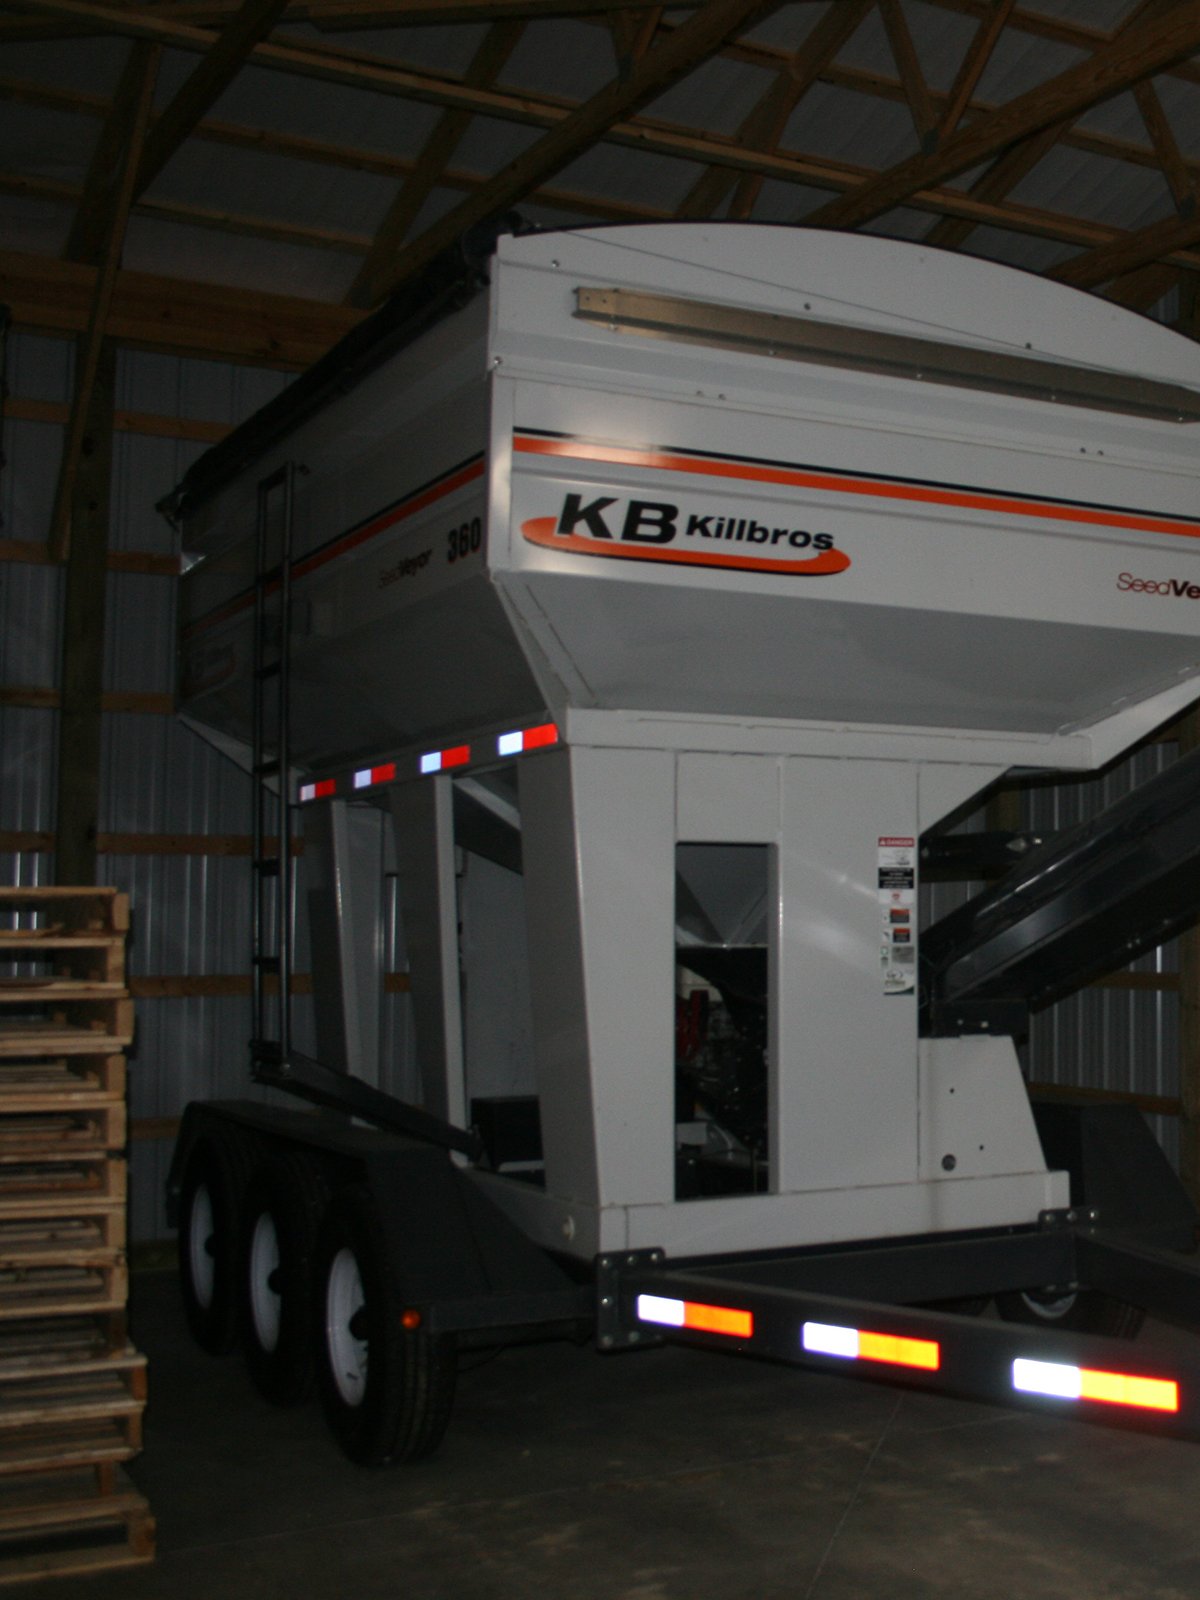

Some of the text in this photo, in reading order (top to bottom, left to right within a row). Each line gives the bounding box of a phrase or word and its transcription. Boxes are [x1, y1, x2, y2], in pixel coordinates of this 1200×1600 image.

[448, 517, 480, 563] 360
[557, 494, 833, 550] KB Killbros
